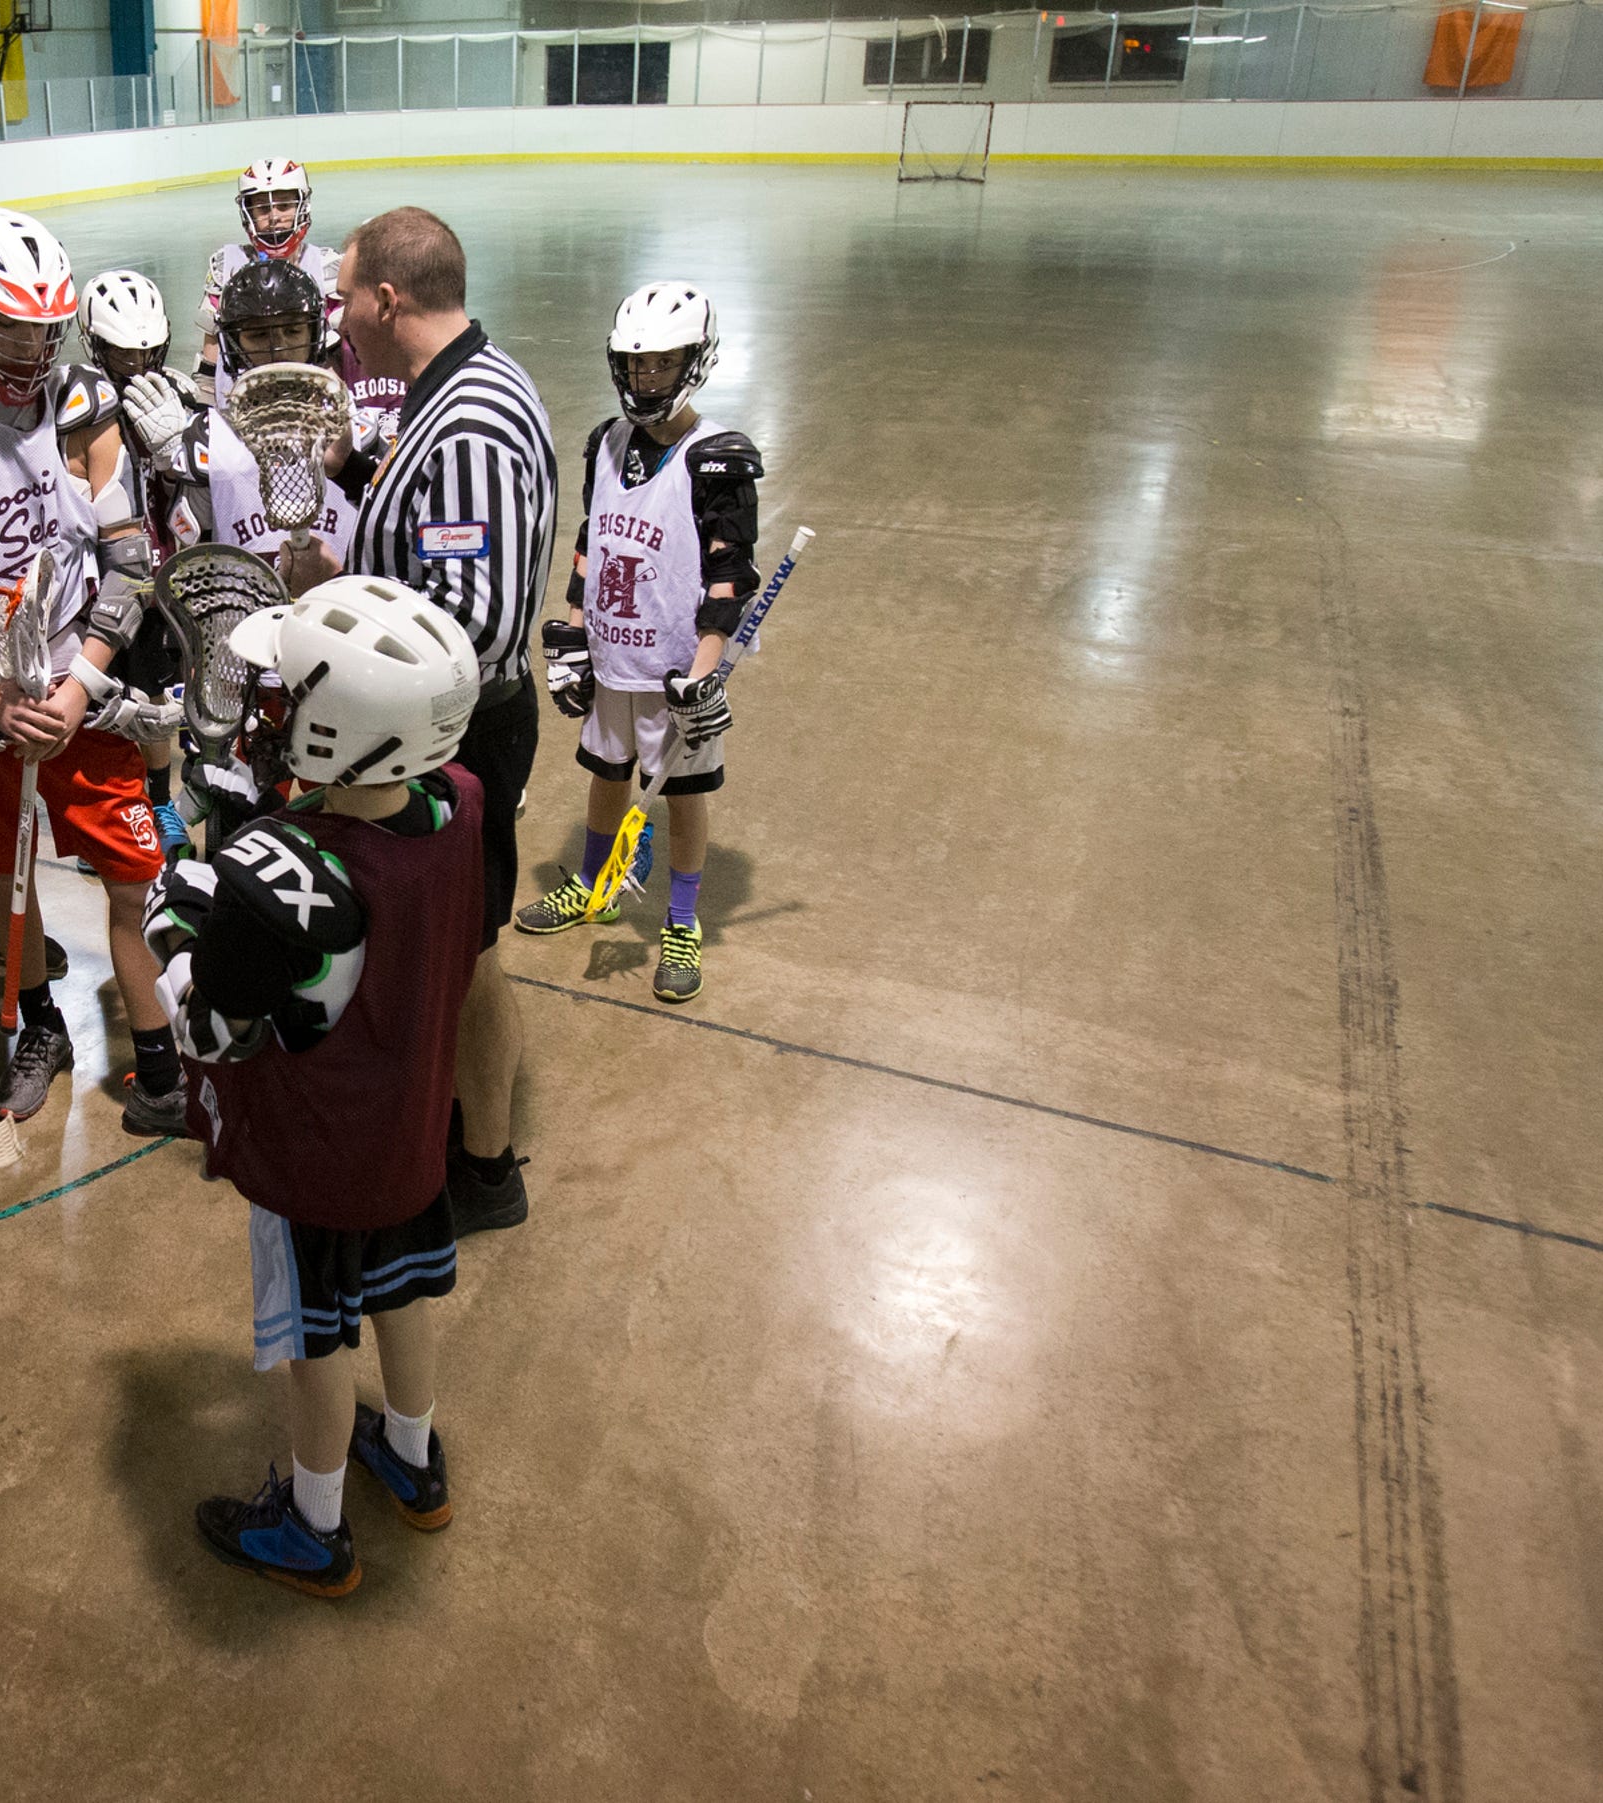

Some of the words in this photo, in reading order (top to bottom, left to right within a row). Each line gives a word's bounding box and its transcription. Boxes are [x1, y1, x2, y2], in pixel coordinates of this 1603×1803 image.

[699, 461, 727, 473] STX
[735, 555, 796, 648] MAVERIK
[588, 609, 657, 648] LROSSE
[119, 803, 150, 822] USA
[220, 829, 336, 932] STX
